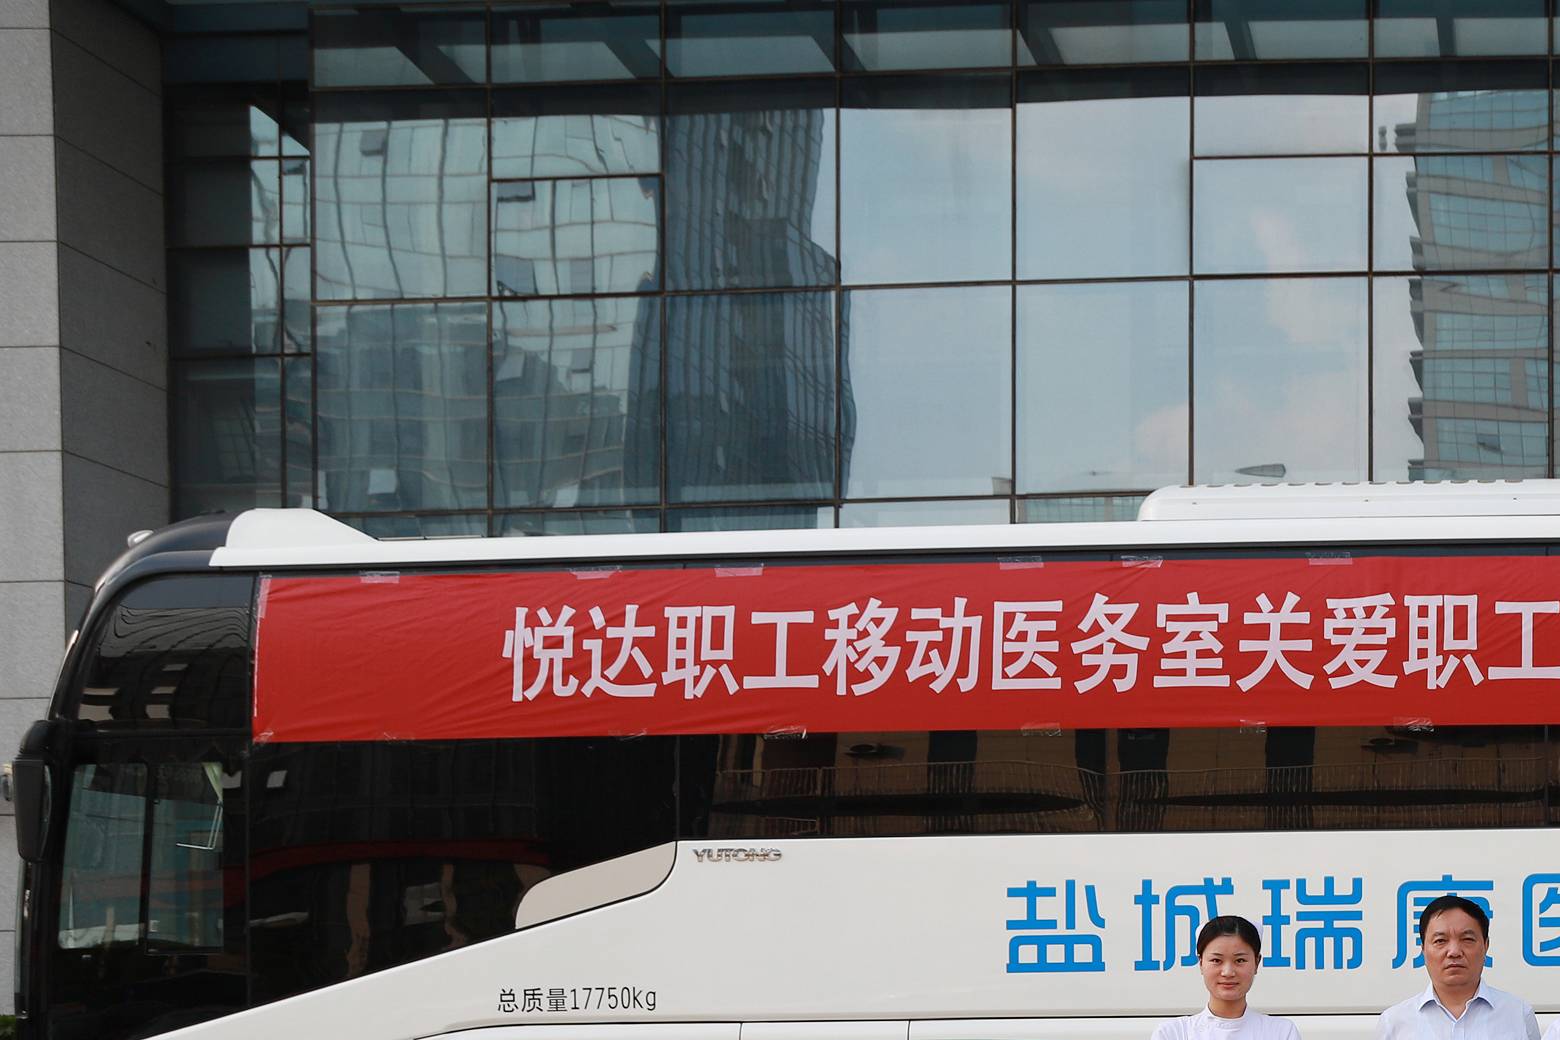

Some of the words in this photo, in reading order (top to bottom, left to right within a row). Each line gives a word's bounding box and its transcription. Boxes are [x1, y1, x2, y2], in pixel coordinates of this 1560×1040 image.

[692, 847, 782, 862] YUTONG
[497, 986, 657, 1013] 总质量17750kg
